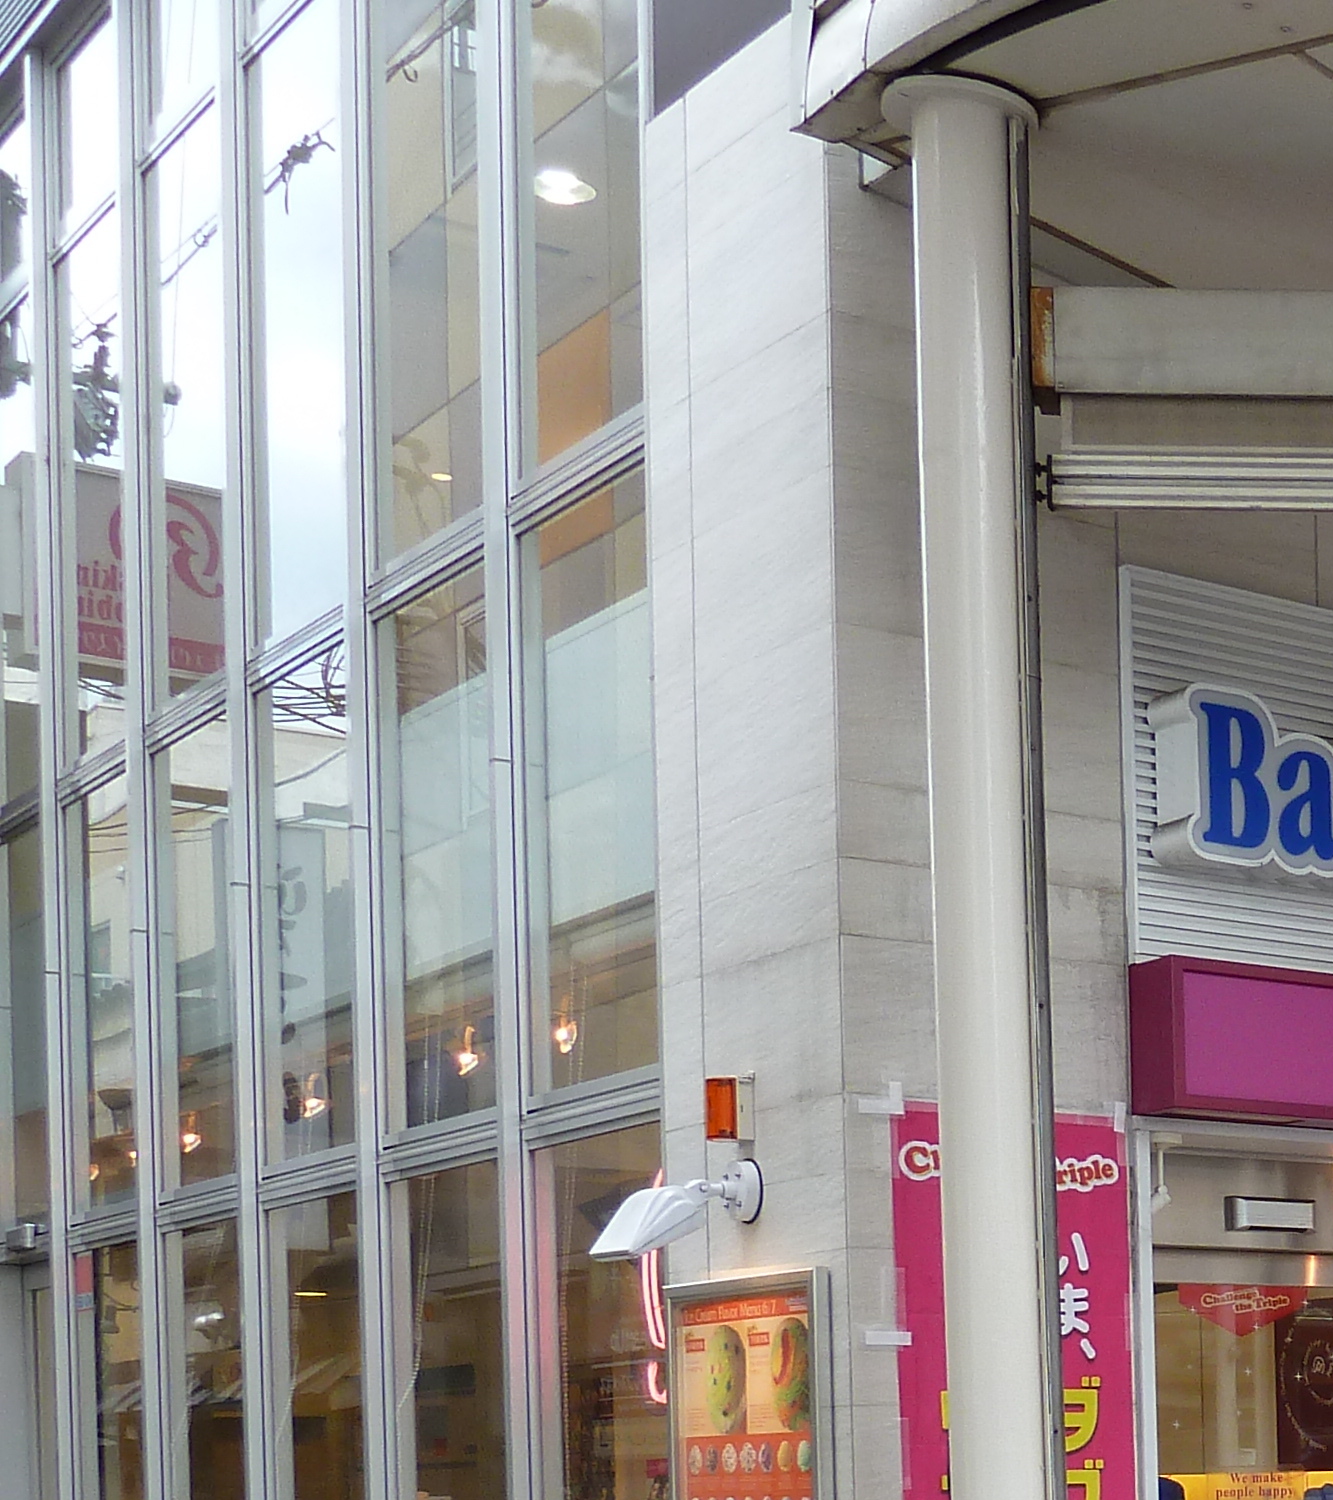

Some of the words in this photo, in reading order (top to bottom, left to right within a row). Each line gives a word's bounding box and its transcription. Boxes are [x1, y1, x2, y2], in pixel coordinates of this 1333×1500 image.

[1202, 1287, 1258, 1307] Challenge
[1234, 1301, 1256, 1313] the
[1255, 1296, 1290, 1310] Triple
[1230, 1472, 1249, 1484] We
[1252, 1472, 1284, 1484] make
[1215, 1485, 1255, 1500] people
[1258, 1485, 1294, 1500] happy
